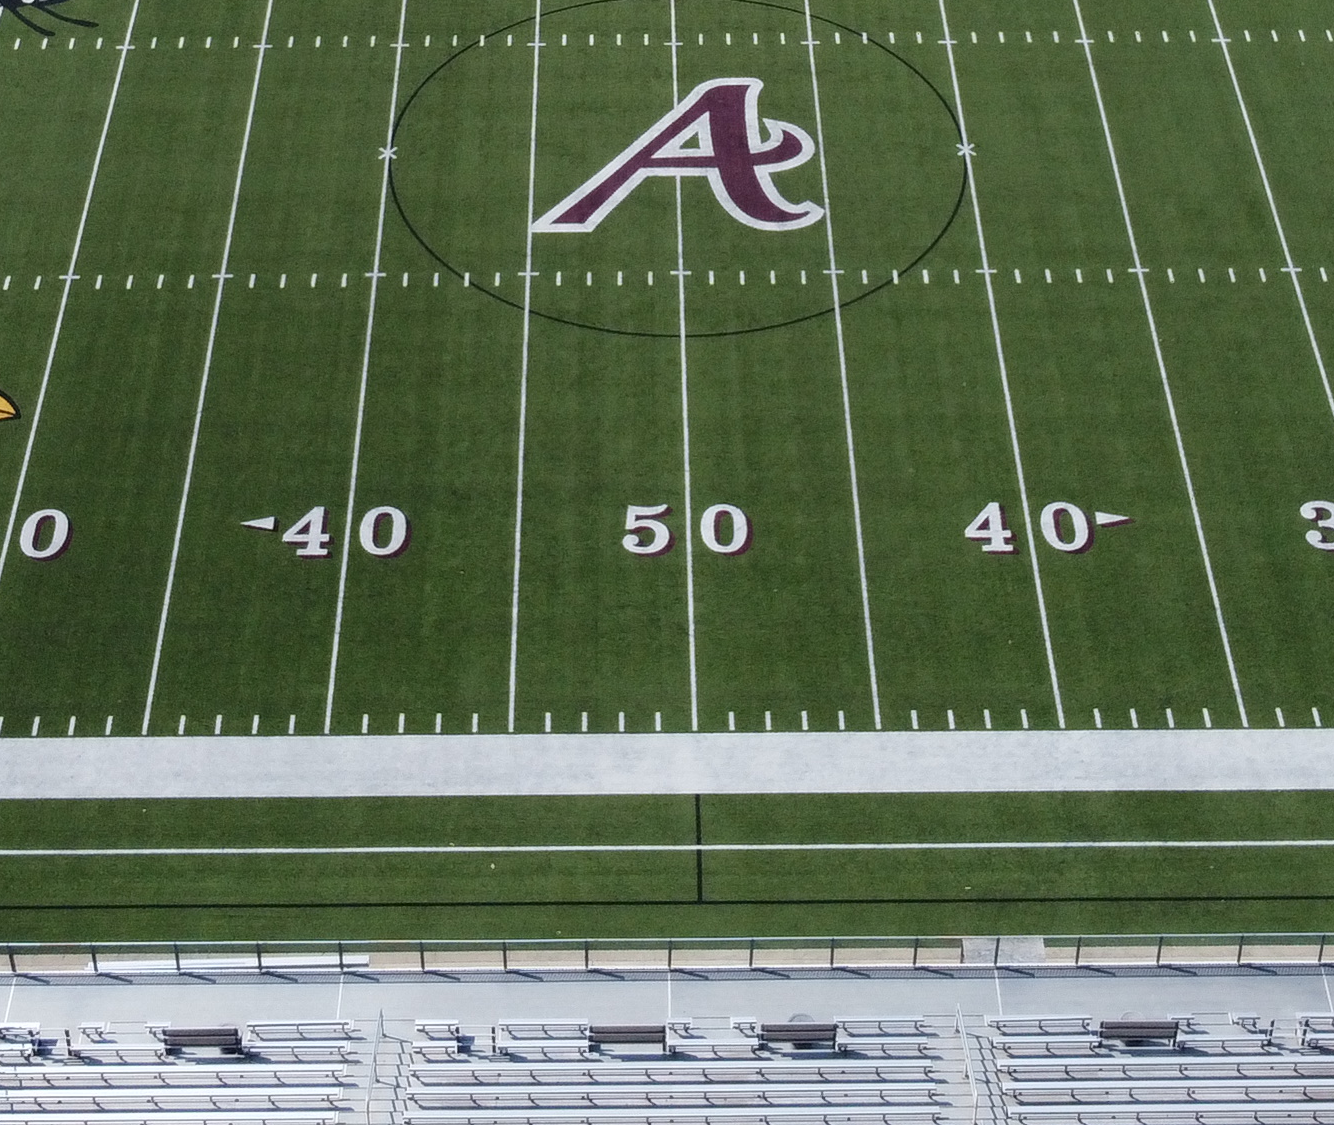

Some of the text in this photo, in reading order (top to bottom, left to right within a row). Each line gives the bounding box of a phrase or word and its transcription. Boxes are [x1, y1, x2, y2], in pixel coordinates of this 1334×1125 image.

[531, 77, 825, 233] A
[281, 505, 410, 558] 40
[621, 503, 752, 556] 50
[965, 501, 1094, 554] 40
